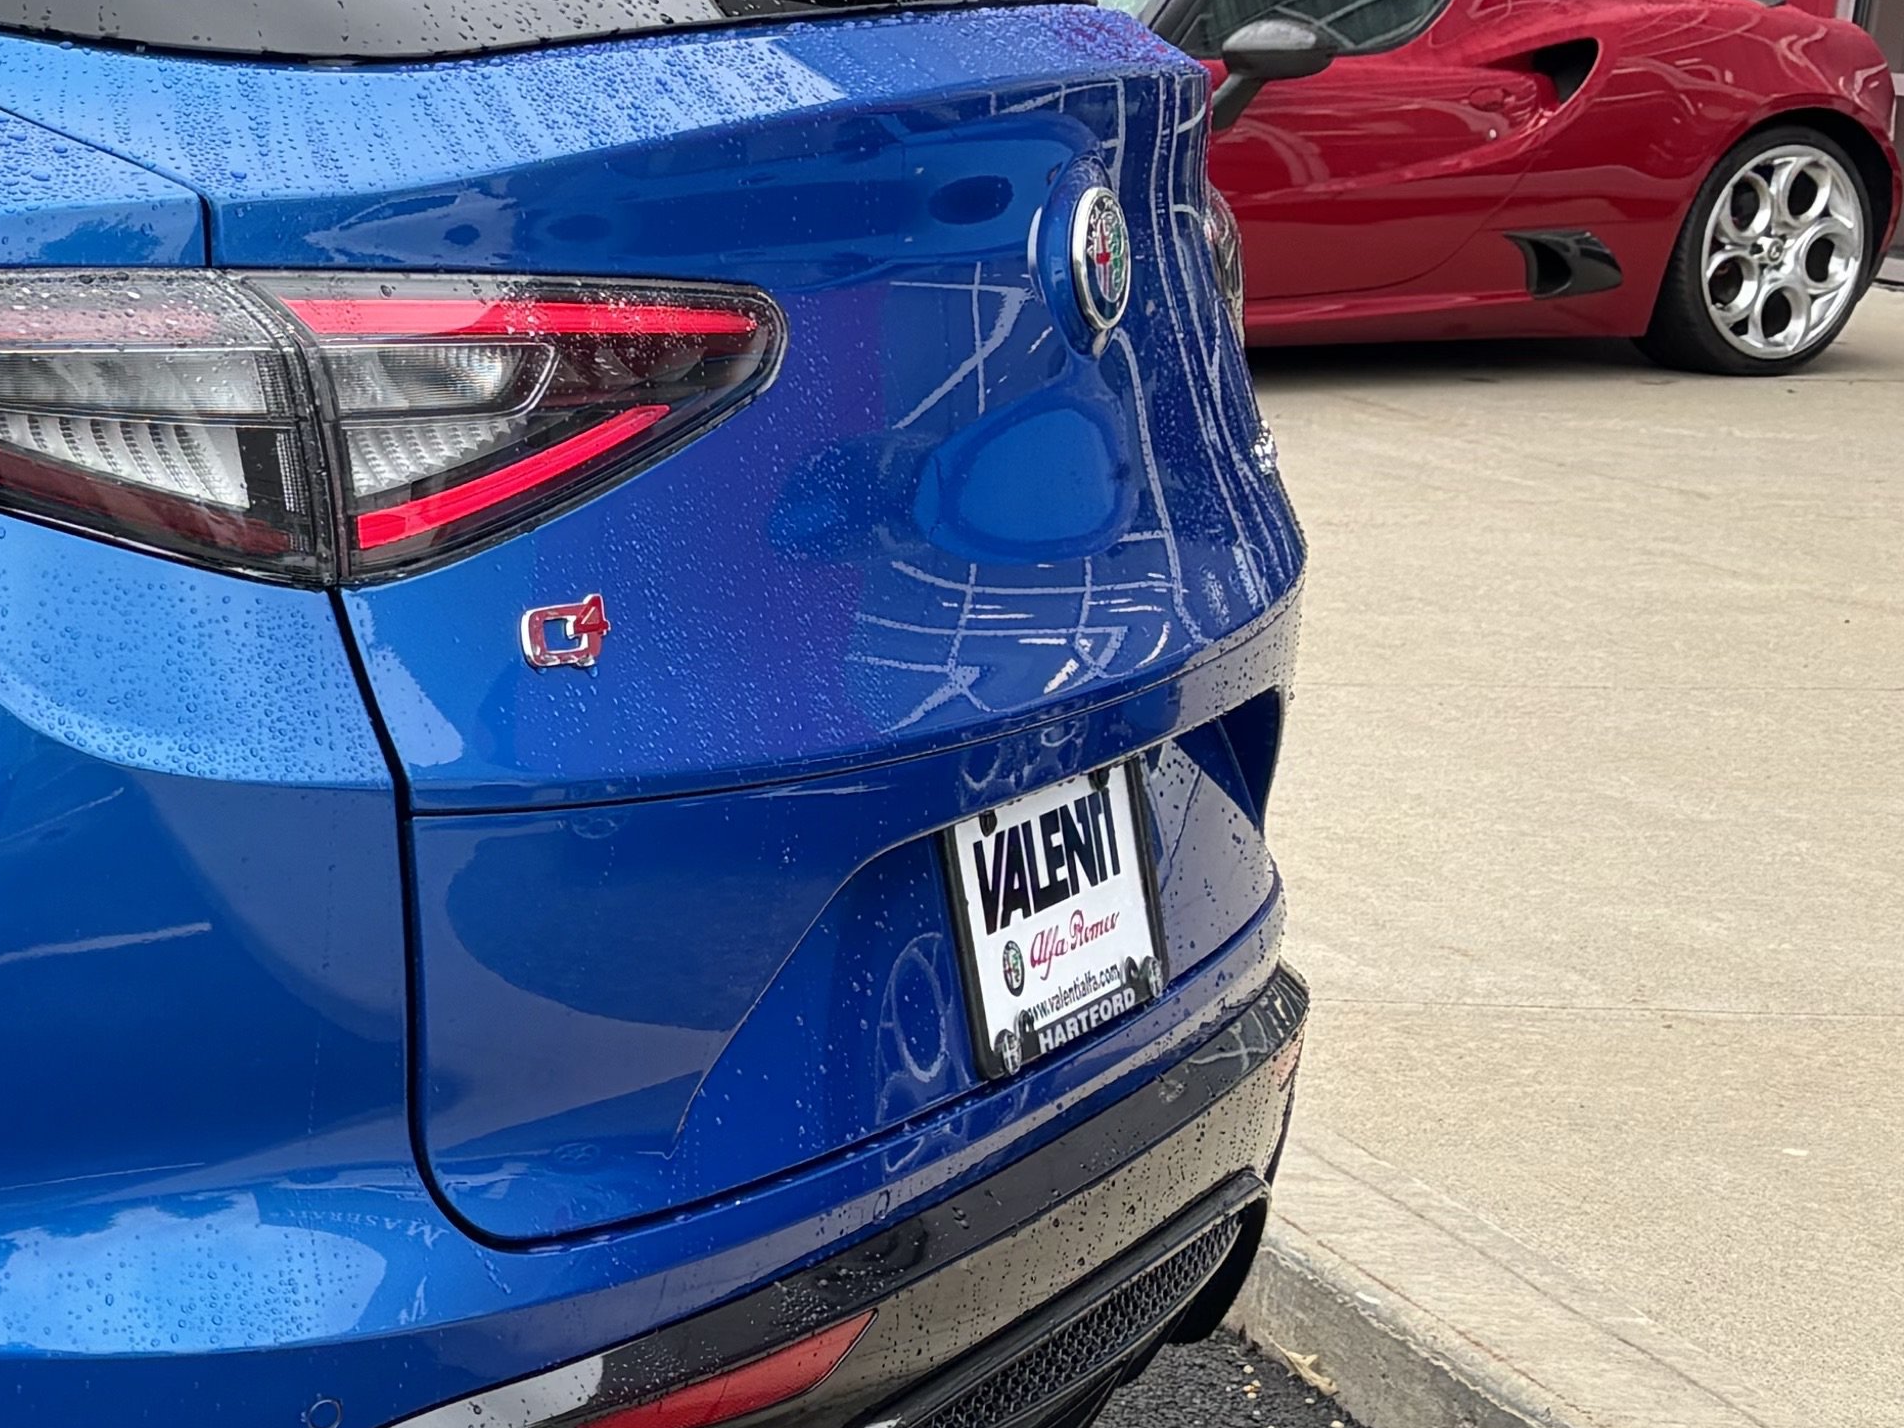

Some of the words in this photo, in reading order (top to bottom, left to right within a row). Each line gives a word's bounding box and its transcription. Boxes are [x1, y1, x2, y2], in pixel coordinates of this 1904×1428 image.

[520, 592, 612, 668] Q4
[972, 786, 1121, 936] VALENTI
[1030, 924, 1069, 981] Alfa
[1069, 909, 1120, 951] Romeo
[1028, 963, 1122, 1022] ww.valentialfa.com
[1037, 987, 1136, 1054] HARTFORD
